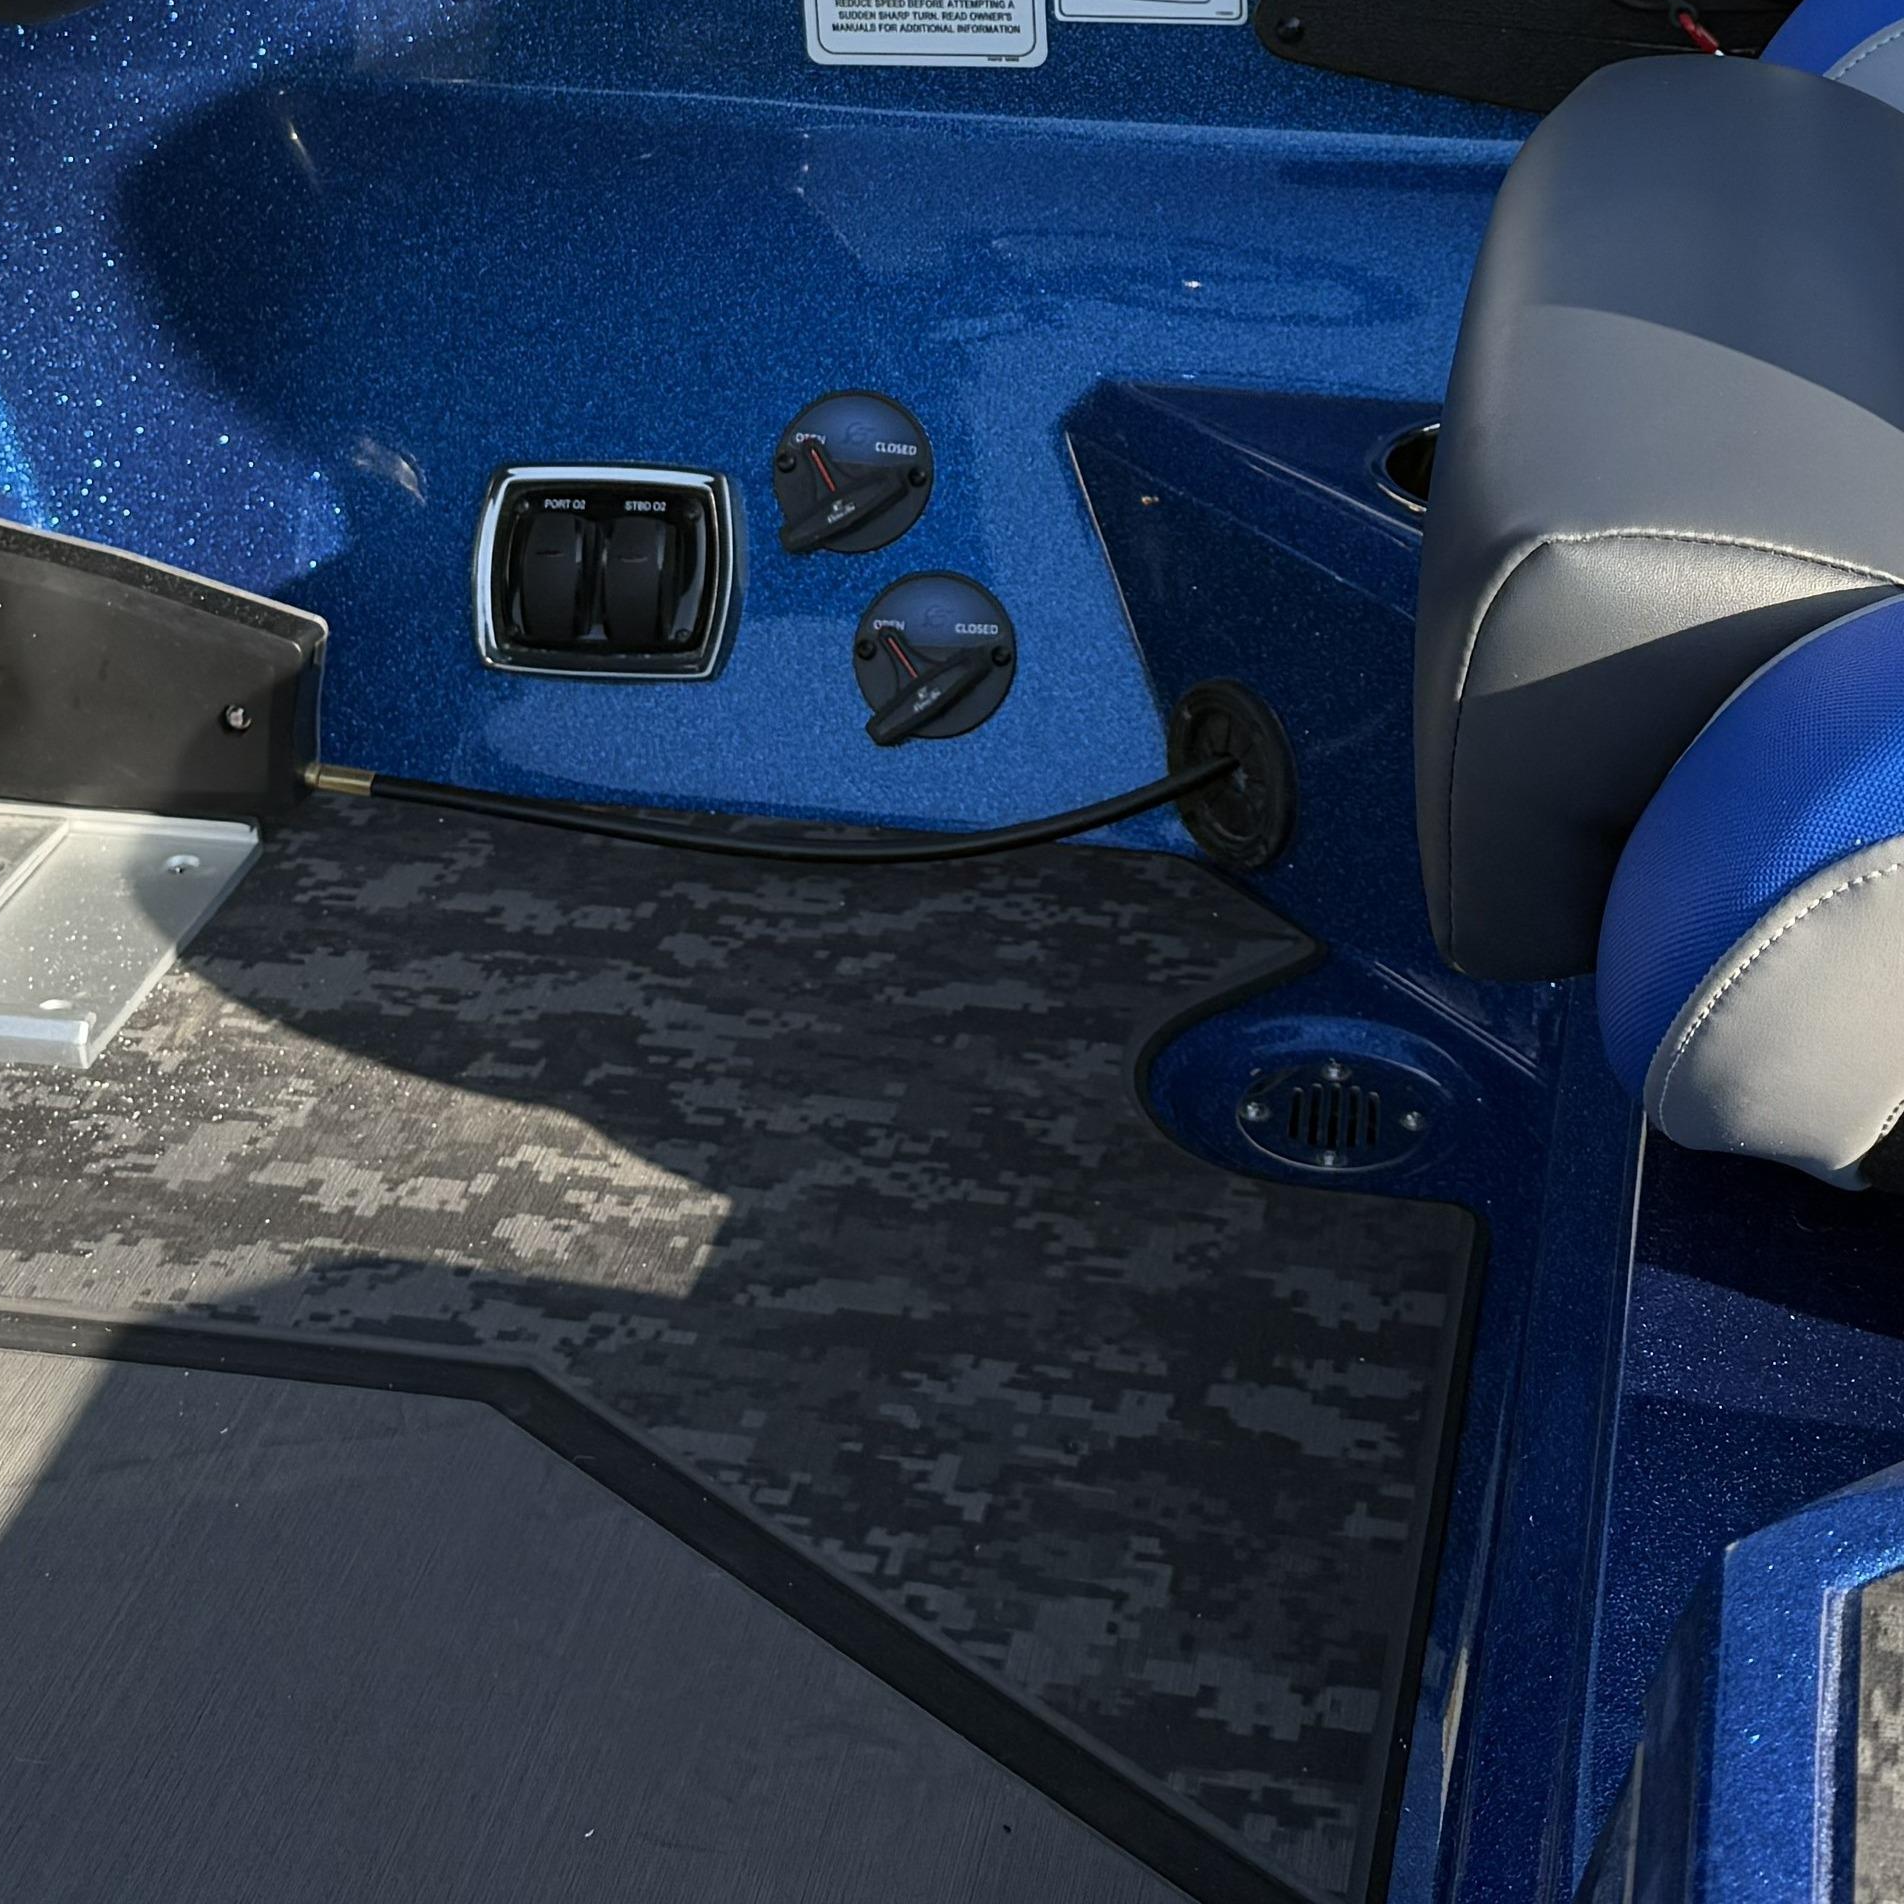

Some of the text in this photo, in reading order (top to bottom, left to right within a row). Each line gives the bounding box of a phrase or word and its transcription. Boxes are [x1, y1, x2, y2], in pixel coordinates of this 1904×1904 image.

[835, 0, 1015, 9] REDUCE SPEED BEFORE ATTEMPTING A
[838, 11, 876, 20] SUDDEN
[878, 11, 909, 20] SHARP
[941, 12, 967, 21] READ
[969, 12, 1012, 21] OWNER'S
[831, 24, 1020, 33] MANUALS FOR ADDITIONAL INFORMATION
[875, 441, 918, 456] CLOSED
[544, 498, 571, 510] PORT
[624, 500, 652, 512] STBD
[954, 622, 999, 635] CLOSED
